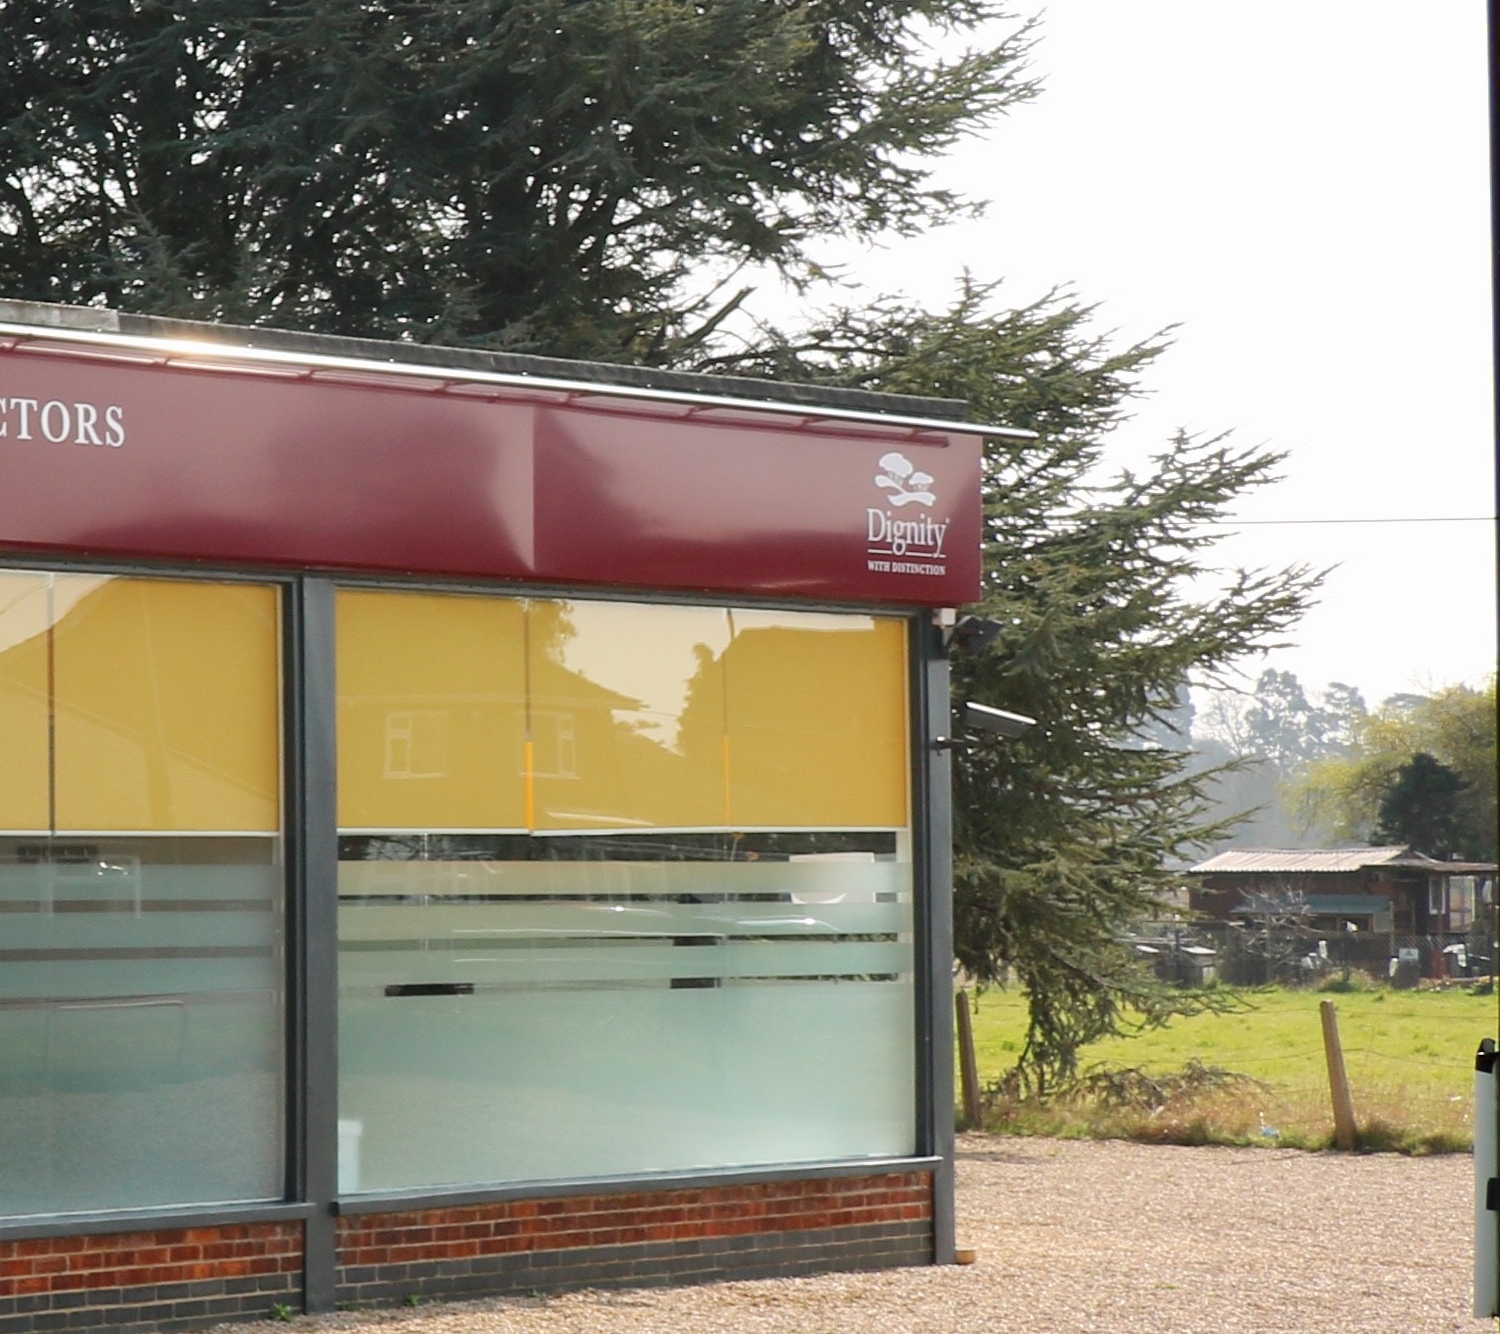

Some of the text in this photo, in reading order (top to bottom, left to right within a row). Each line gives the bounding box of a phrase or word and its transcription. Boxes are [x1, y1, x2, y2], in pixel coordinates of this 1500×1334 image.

[866, 508, 947, 558] Dignity
[867, 560, 946, 576] WITH DISTINCTION
